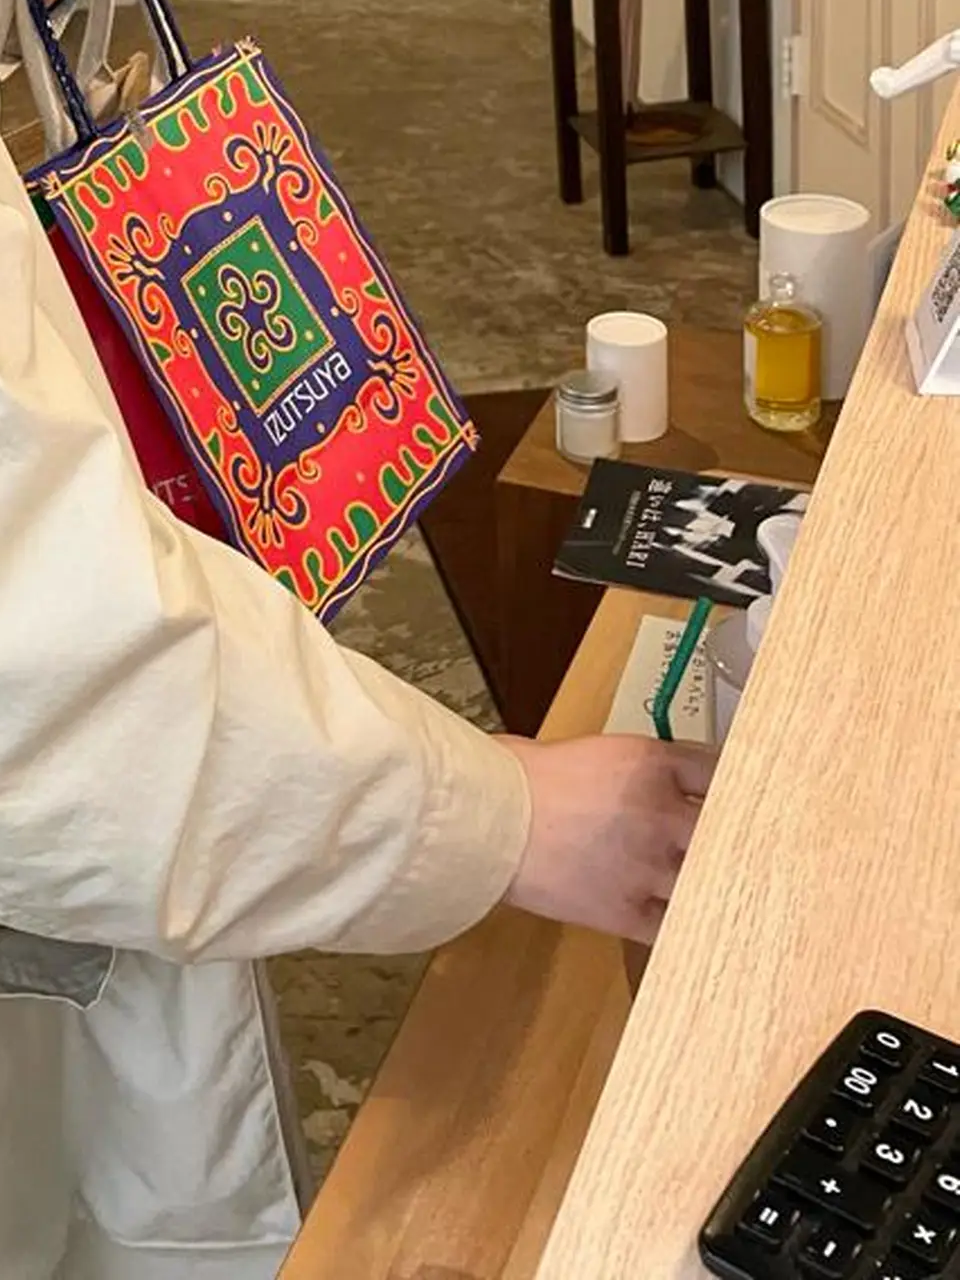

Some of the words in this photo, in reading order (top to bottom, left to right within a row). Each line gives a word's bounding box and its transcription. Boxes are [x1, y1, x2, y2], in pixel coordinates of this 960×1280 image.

[876, 1032, 901, 1049] 0
[932, 1061, 959, 1077] 1
[843, 1067, 878, 1095] 00
[903, 1098, 933, 1120] 2
[875, 1143, 905, 1164] 3
